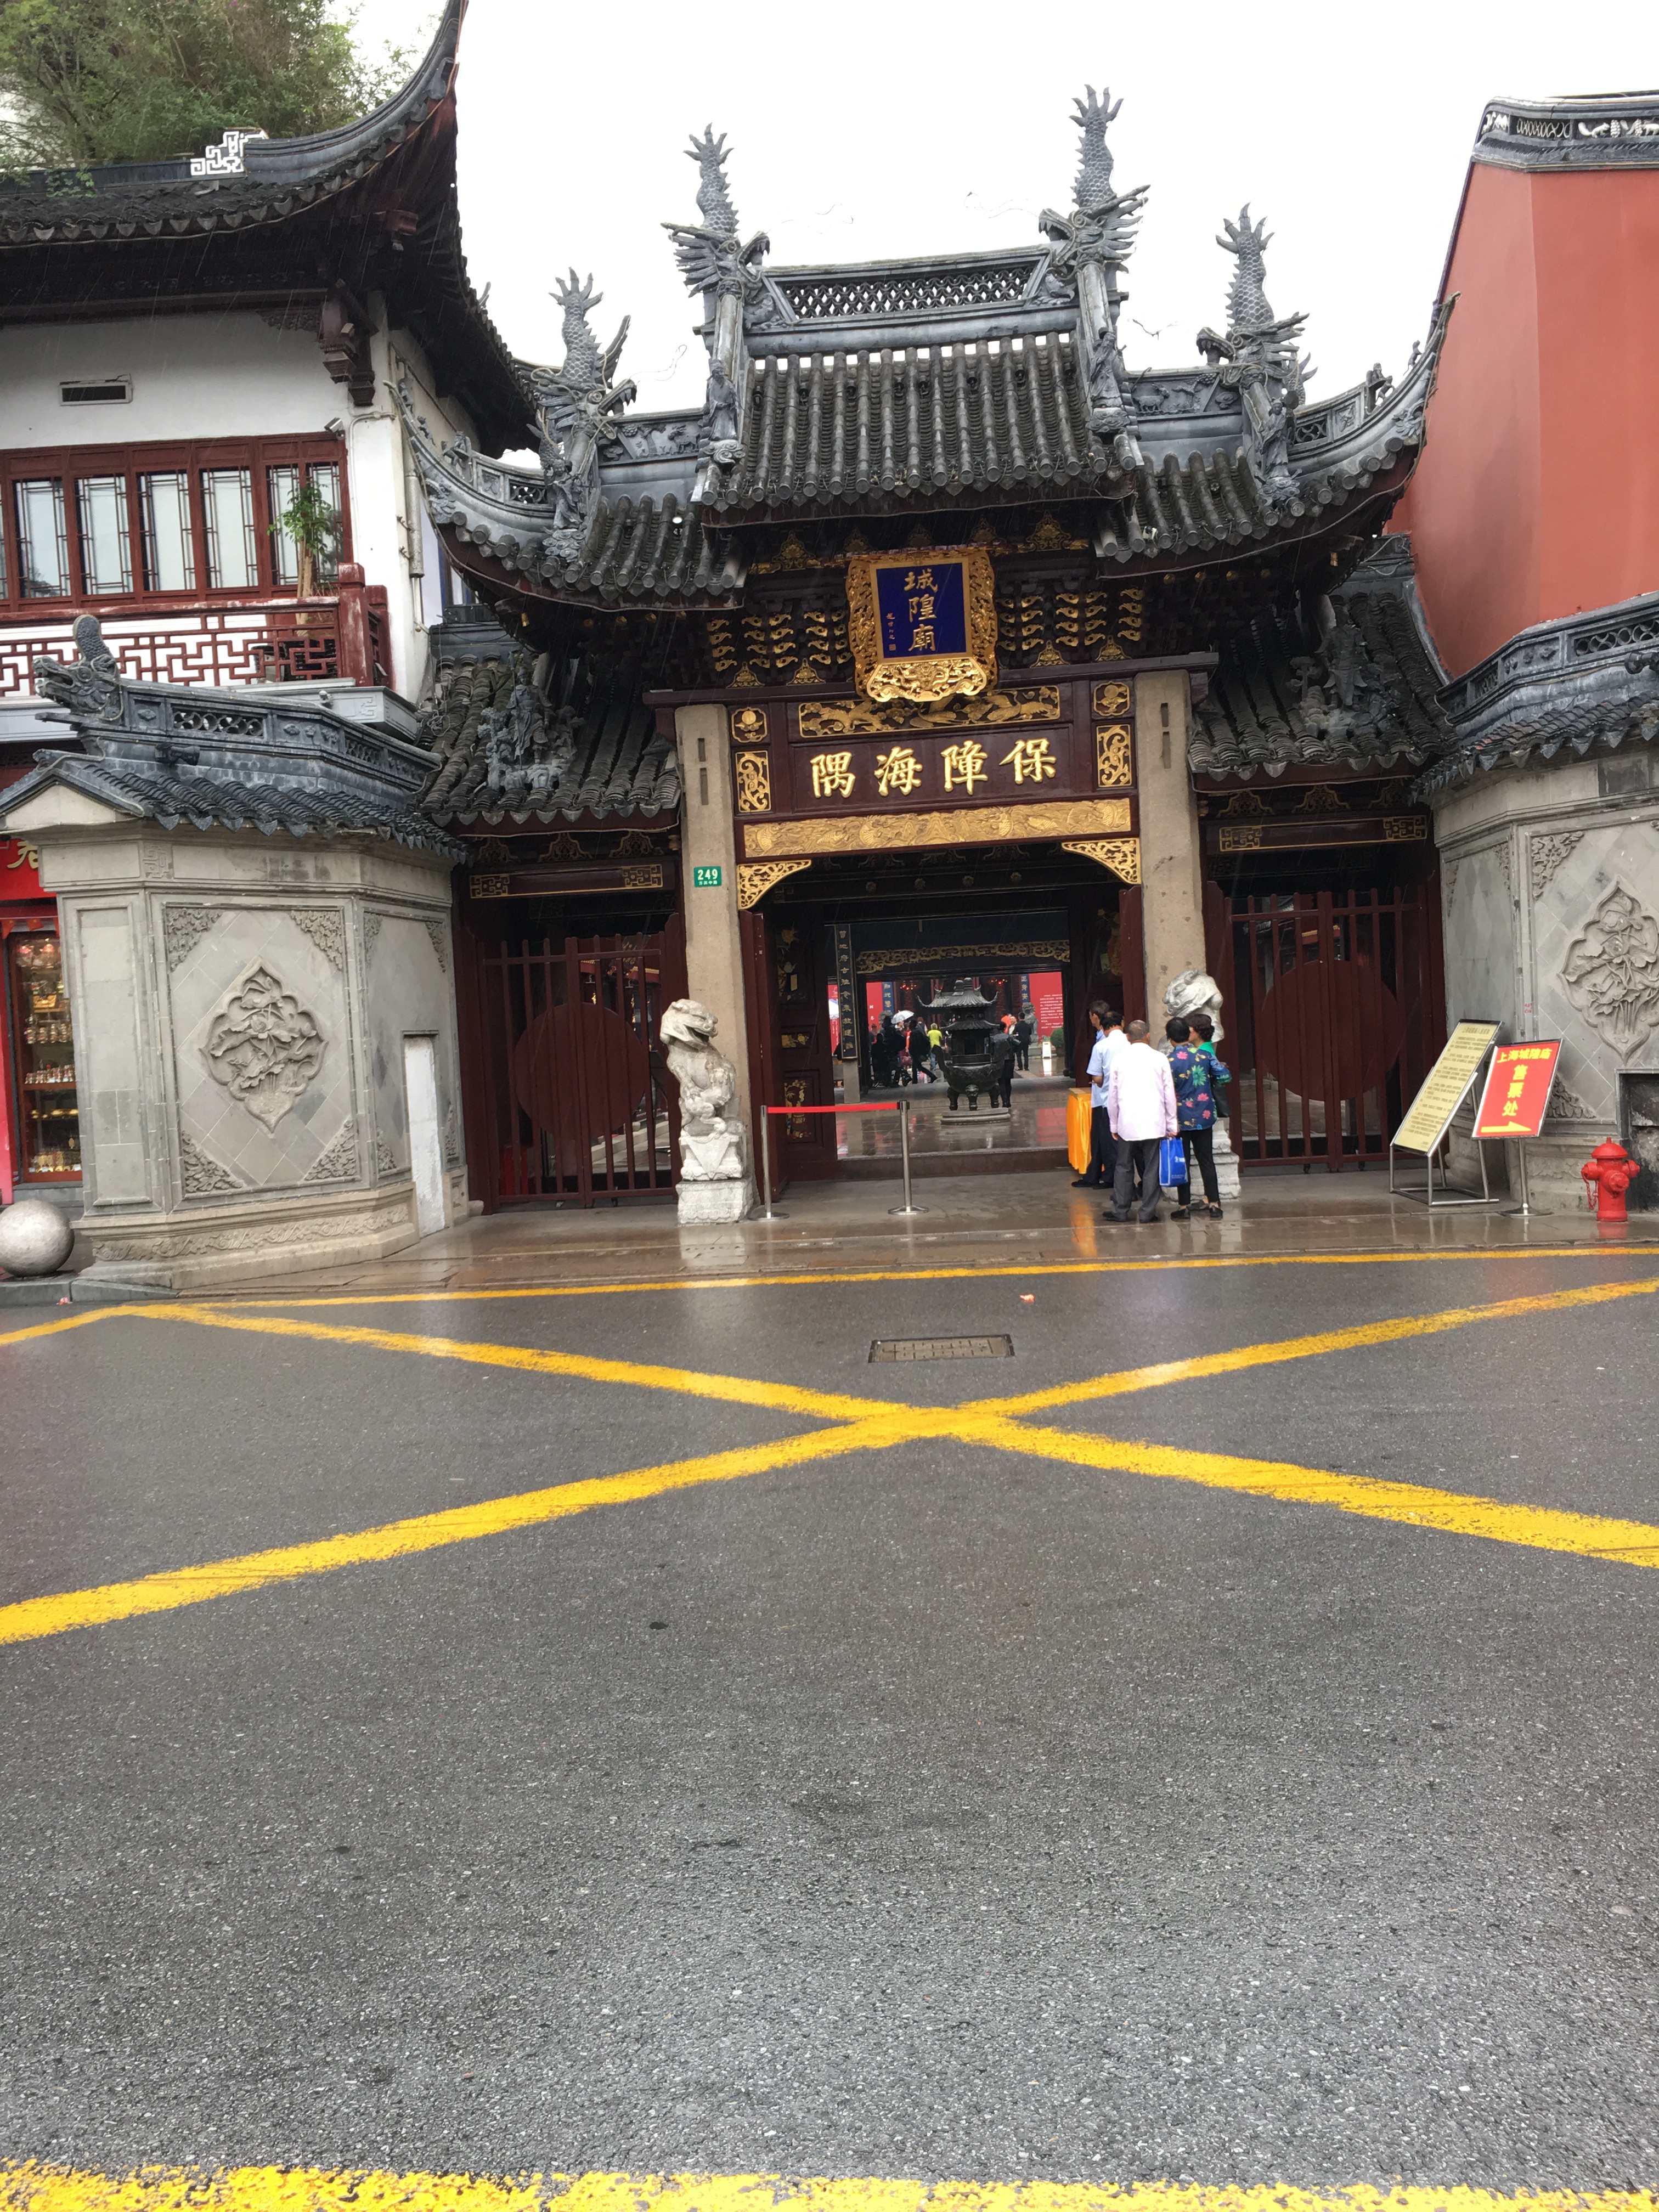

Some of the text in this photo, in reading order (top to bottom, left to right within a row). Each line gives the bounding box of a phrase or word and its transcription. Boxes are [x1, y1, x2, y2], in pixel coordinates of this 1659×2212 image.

[904, 568, 938, 652] 城隍廟
[697, 868, 718, 880] 249
[1497, 1048, 1553, 1063] 上海城隍庙
[1502, 1064, 1528, 1117] 售票处
